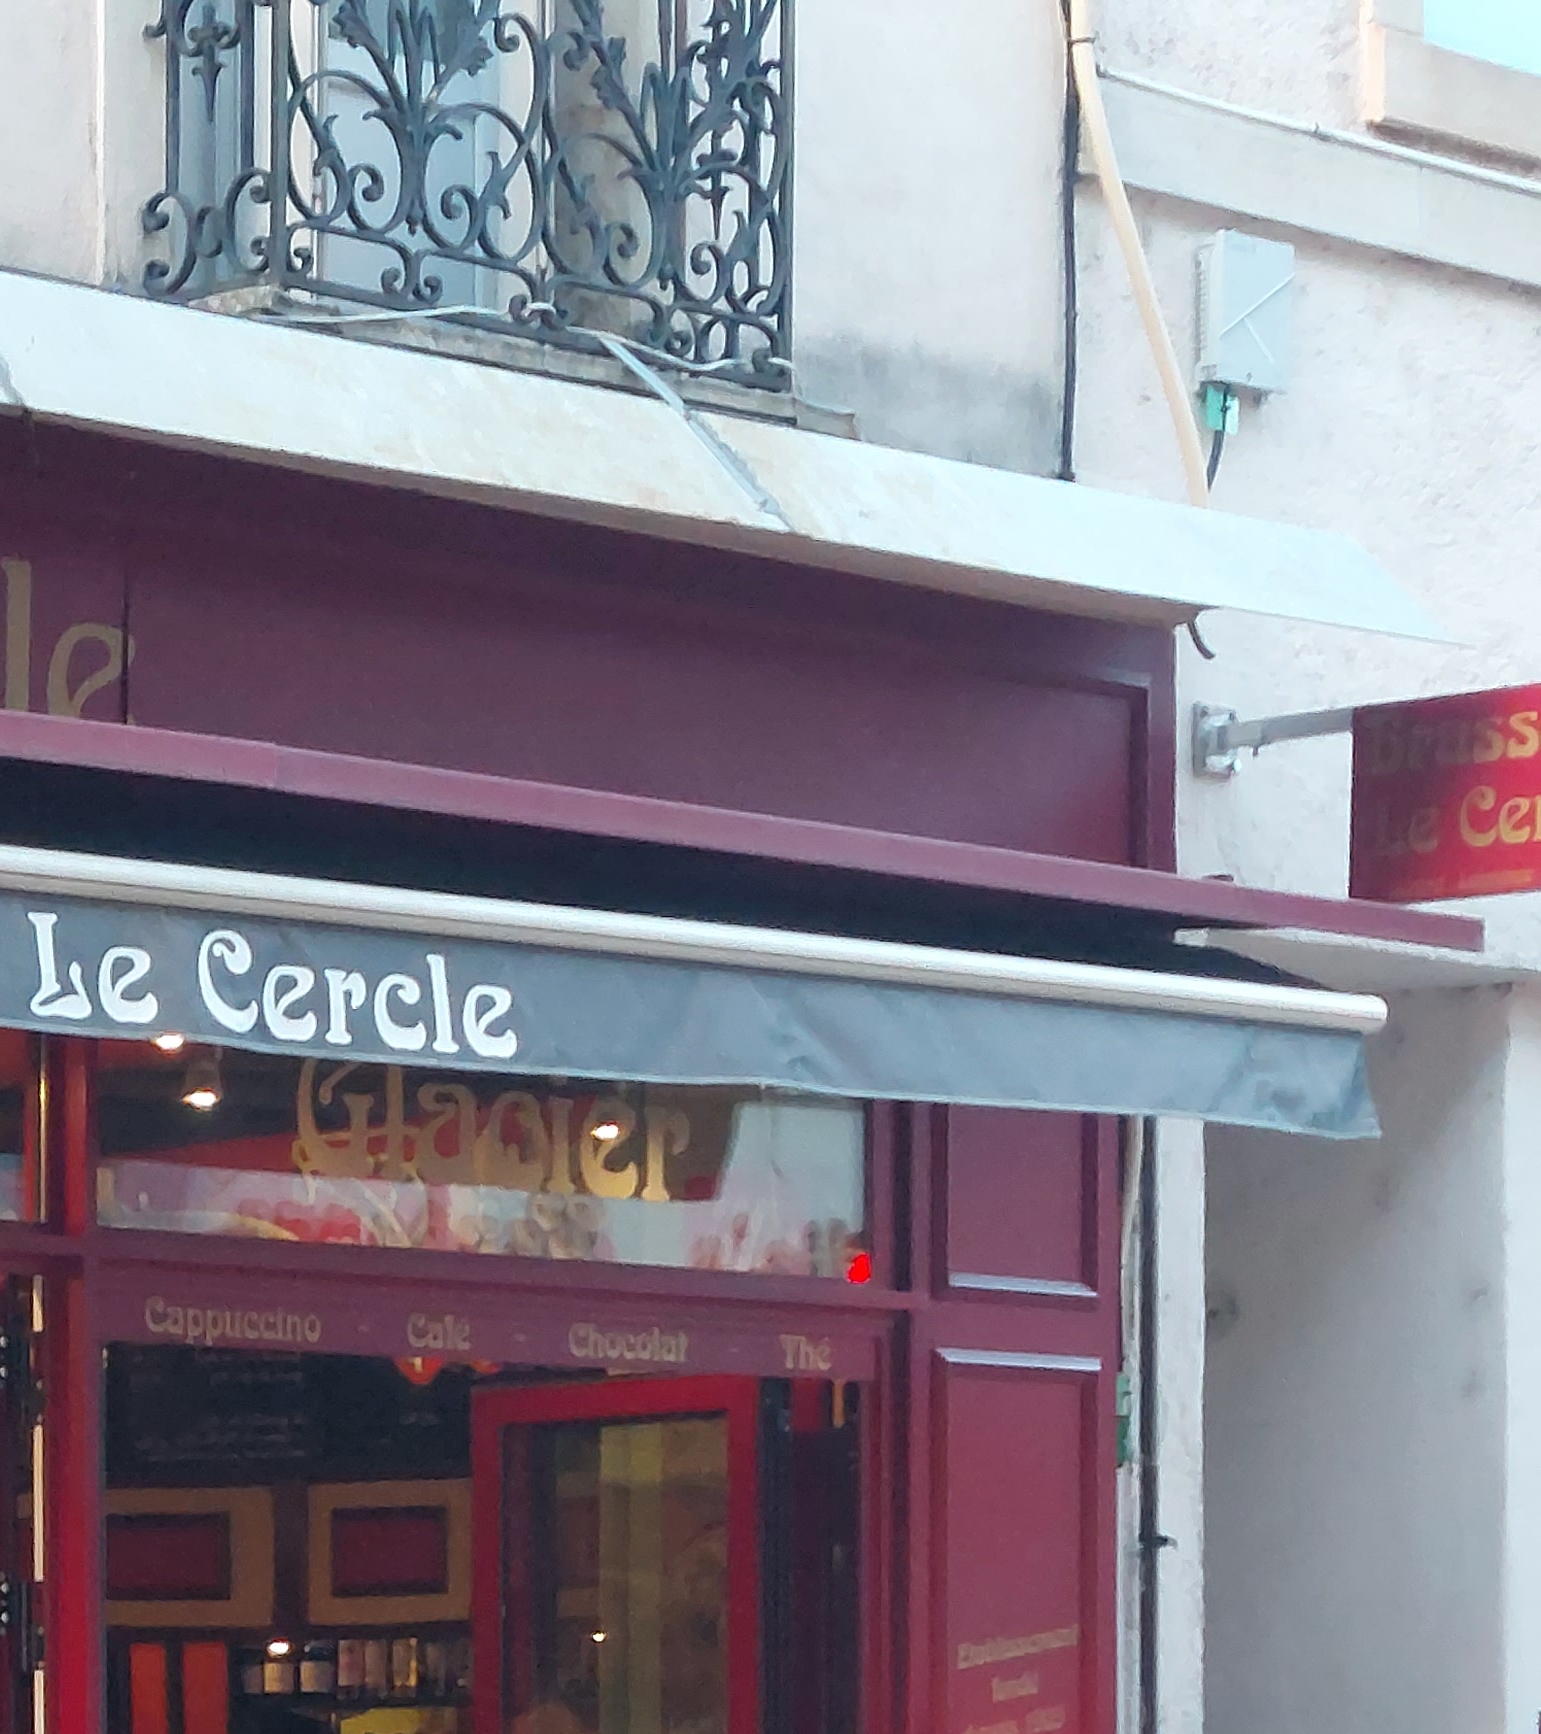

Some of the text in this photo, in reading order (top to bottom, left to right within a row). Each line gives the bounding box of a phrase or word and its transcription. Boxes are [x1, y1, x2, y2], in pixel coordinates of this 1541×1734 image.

[28, 911, 518, 1058] Le Cercle
[295, 1055, 691, 1203] Glacier
[144, 1297, 322, 1347] Cappuccino
[569, 1322, 689, 1364] Chocolat
